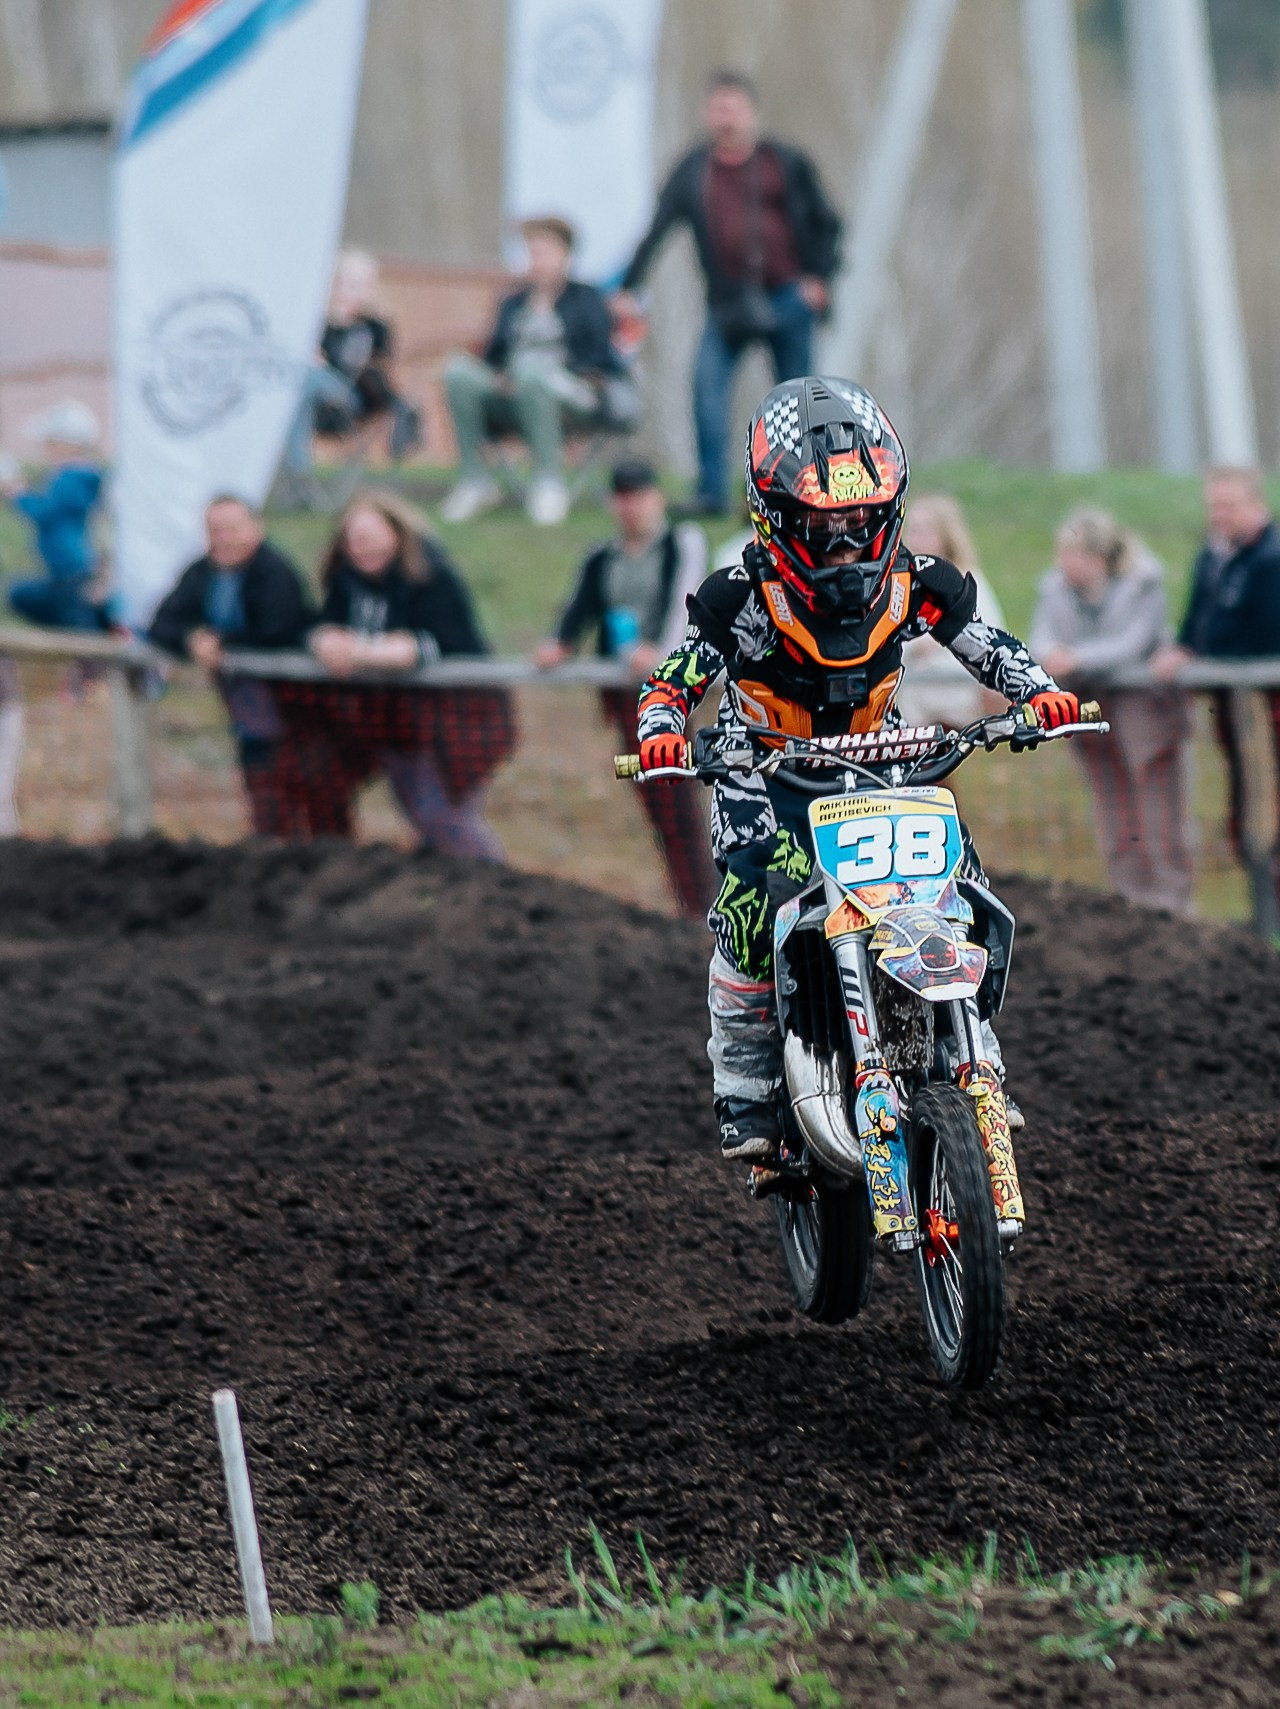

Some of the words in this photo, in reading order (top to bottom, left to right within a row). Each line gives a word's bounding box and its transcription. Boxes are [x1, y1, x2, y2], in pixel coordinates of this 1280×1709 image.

[819, 797, 871, 812] MIKHAIL
[819, 805, 892, 822] ARTISEVICH
[836, 815, 947, 885] 38
